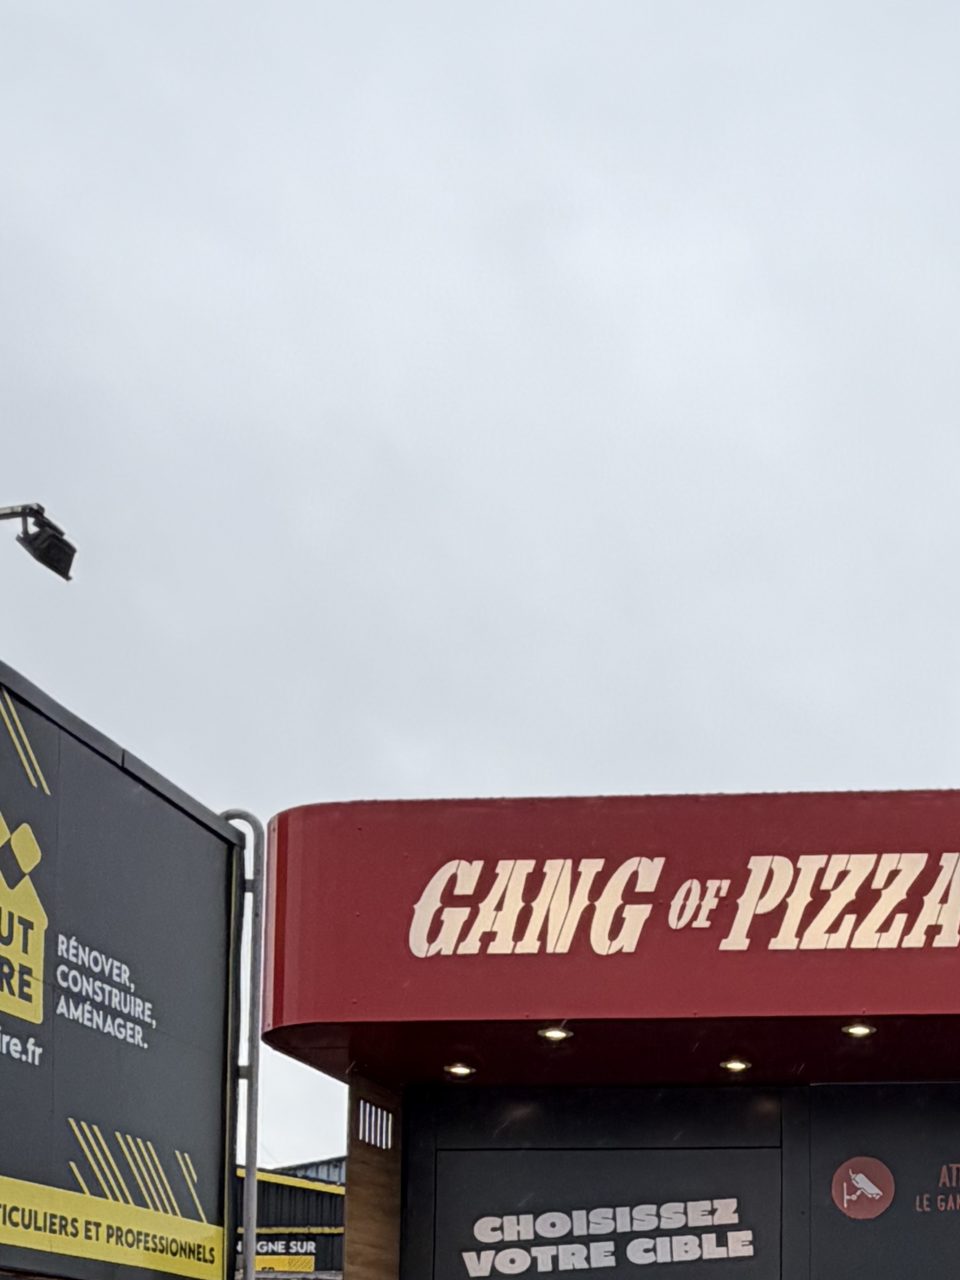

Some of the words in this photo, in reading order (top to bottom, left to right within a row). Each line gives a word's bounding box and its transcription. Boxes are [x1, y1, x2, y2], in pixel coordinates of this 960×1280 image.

[408, 857, 666, 958] GANG
[668, 879, 730, 930] OF
[57, 933, 135, 993] RÉNOVER,
[56, 964, 157, 1029] CONSTRUIRE,
[56, 994, 148, 1049] AMÉNAGER.
[473, 1198, 739, 1243] CHOISISSEZ
[915, 1194, 931, 1212] LE
[84, 1219, 101, 1242] ET
[106, 1223, 215, 1265] PROFESSIONNELS
[289, 1240, 316, 1253] SUR
[462, 1241, 616, 1277] VOTRE
[626, 1230, 754, 1265] CIBLE
